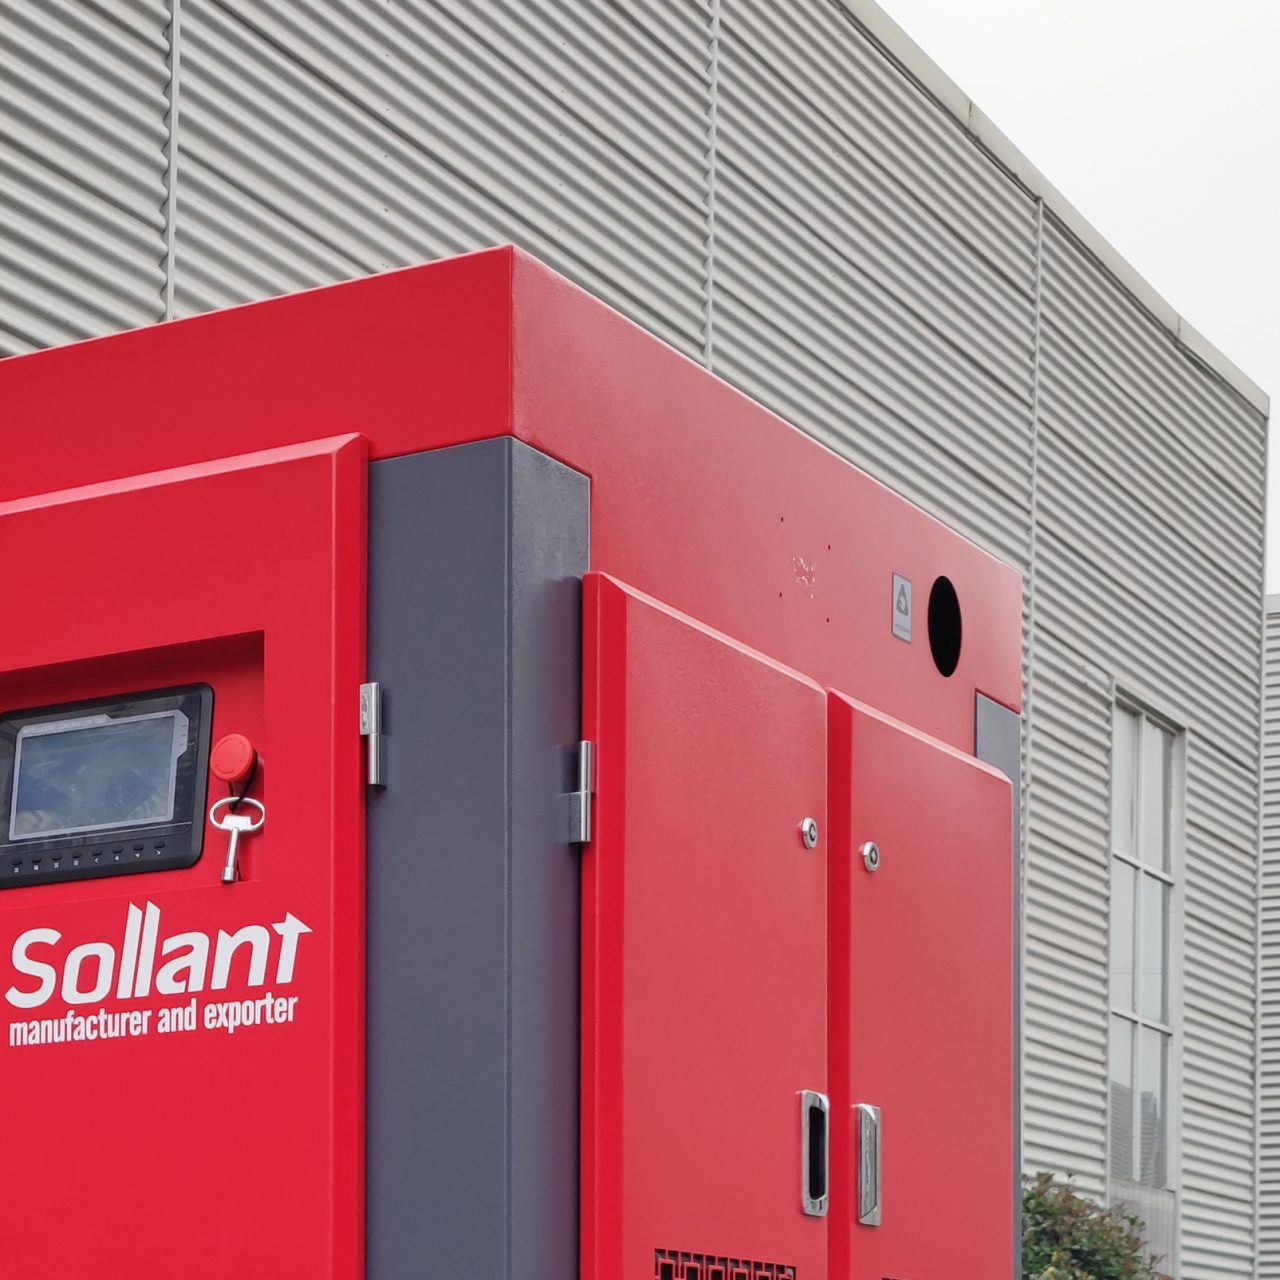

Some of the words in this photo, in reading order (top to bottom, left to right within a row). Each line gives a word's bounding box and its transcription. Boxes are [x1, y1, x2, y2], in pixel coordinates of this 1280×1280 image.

[4, 900, 314, 1009] Sollant
[9, 1008, 152, 1047] manufacturer
[157, 998, 196, 1034] and
[204, 992, 299, 1034] exporter
